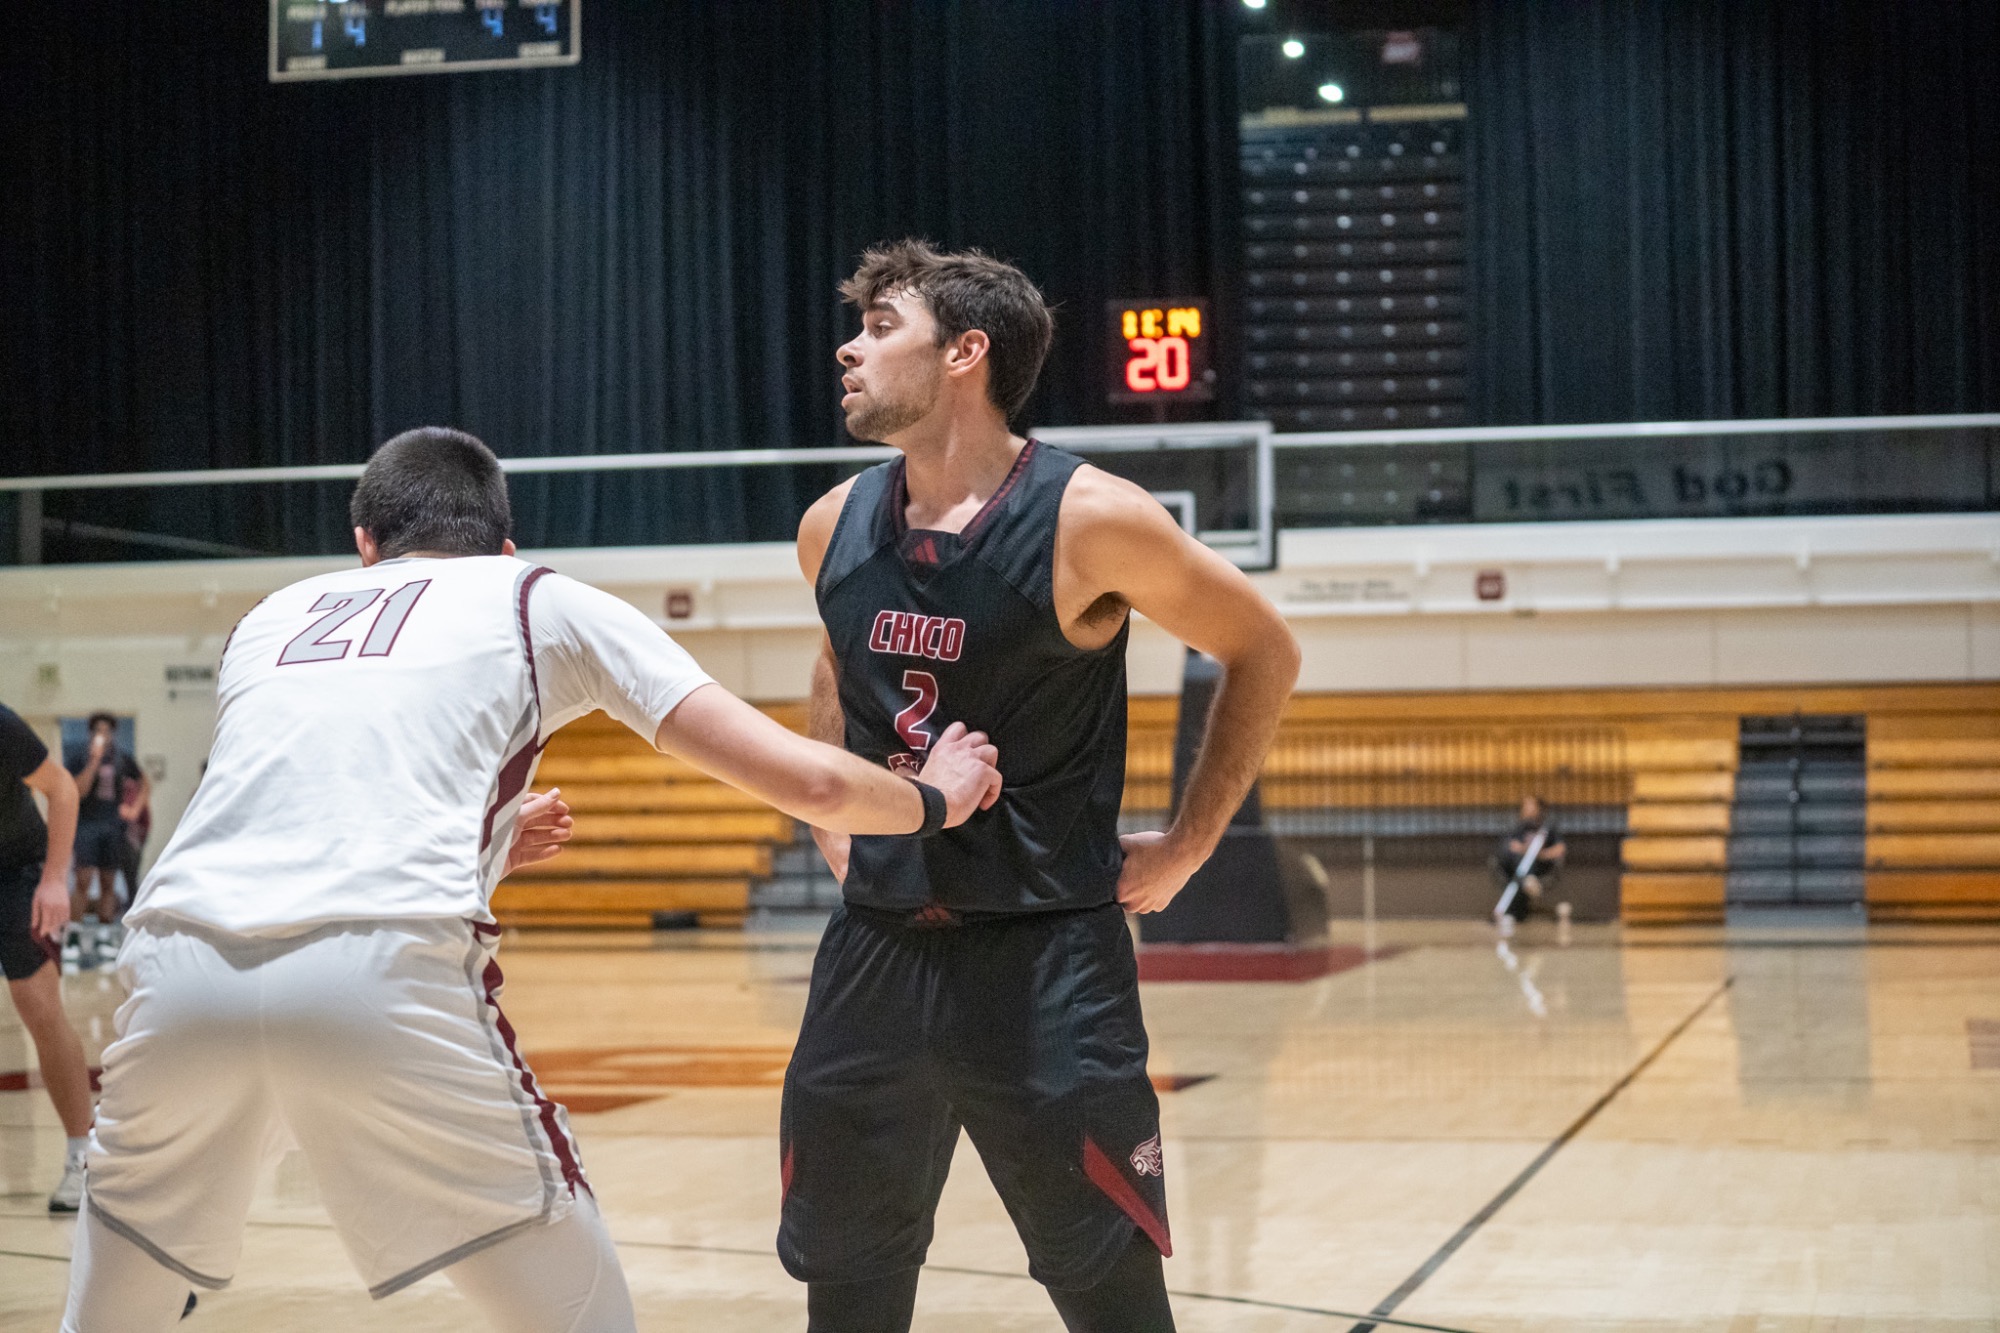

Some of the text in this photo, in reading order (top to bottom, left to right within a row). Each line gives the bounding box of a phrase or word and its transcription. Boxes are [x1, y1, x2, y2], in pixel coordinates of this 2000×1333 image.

[1126, 337, 1190, 392] 20
[276, 579, 433, 667] 21
[869, 610, 966, 662] CHICO
[894, 670, 939, 751] 2
